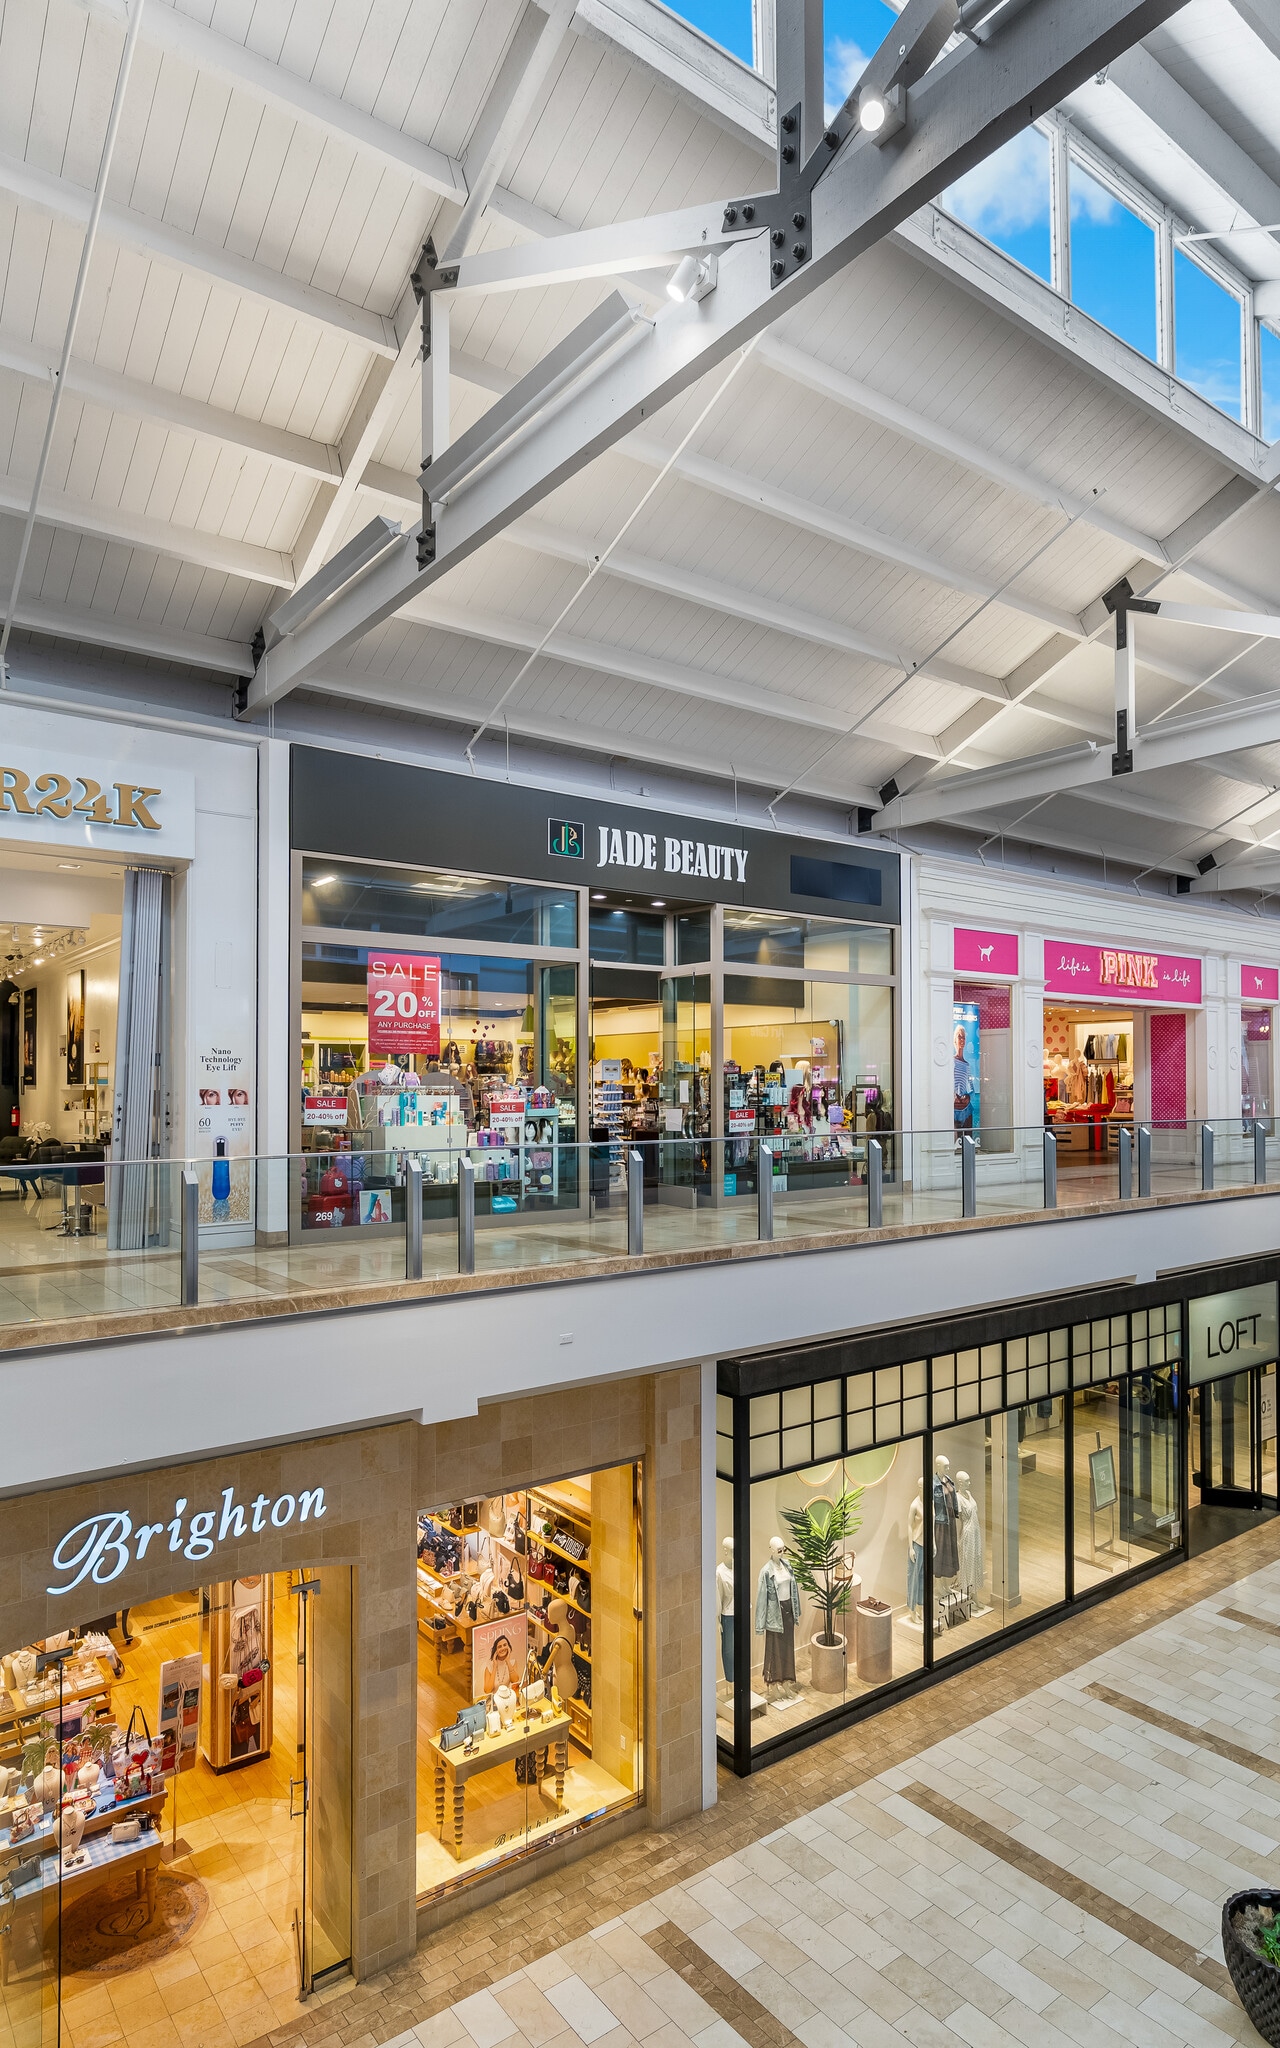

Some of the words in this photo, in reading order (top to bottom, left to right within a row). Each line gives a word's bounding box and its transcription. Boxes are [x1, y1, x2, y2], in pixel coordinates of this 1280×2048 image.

[596, 826, 657, 870] JADE
[663, 837, 749, 883] BEAUTY
[372, 961, 437, 981] SALE
[1057, 956, 1080, 976] life
[1081, 962, 1091, 972] is
[1099, 951, 1159, 988] PINK
[1163, 971, 1171, 981] is
[1171, 969, 1191, 987] life
[373, 990, 418, 1018] 20
[418, 1010, 437, 1018] OFF
[394, 1021, 431, 1030] PURCHASE
[211, 1047, 232, 1055] Nano
[200, 1055, 242, 1065] Technology
[206, 1064, 221, 1072] Eye
[316, 1100, 337, 1108] SALE
[499, 1104, 517, 1112] SALE
[198, 1117, 211, 1127] 60
[315, 1211, 333, 1222] 269
[1207, 1313, 1262, 1358] LOFT
[46, 1486, 327, 1595] Brighton
[938, 1584, 973, 1614] STYLE
[937, 1601, 974, 1632] EVENT
[494, 1808, 570, 1849] Brighton
